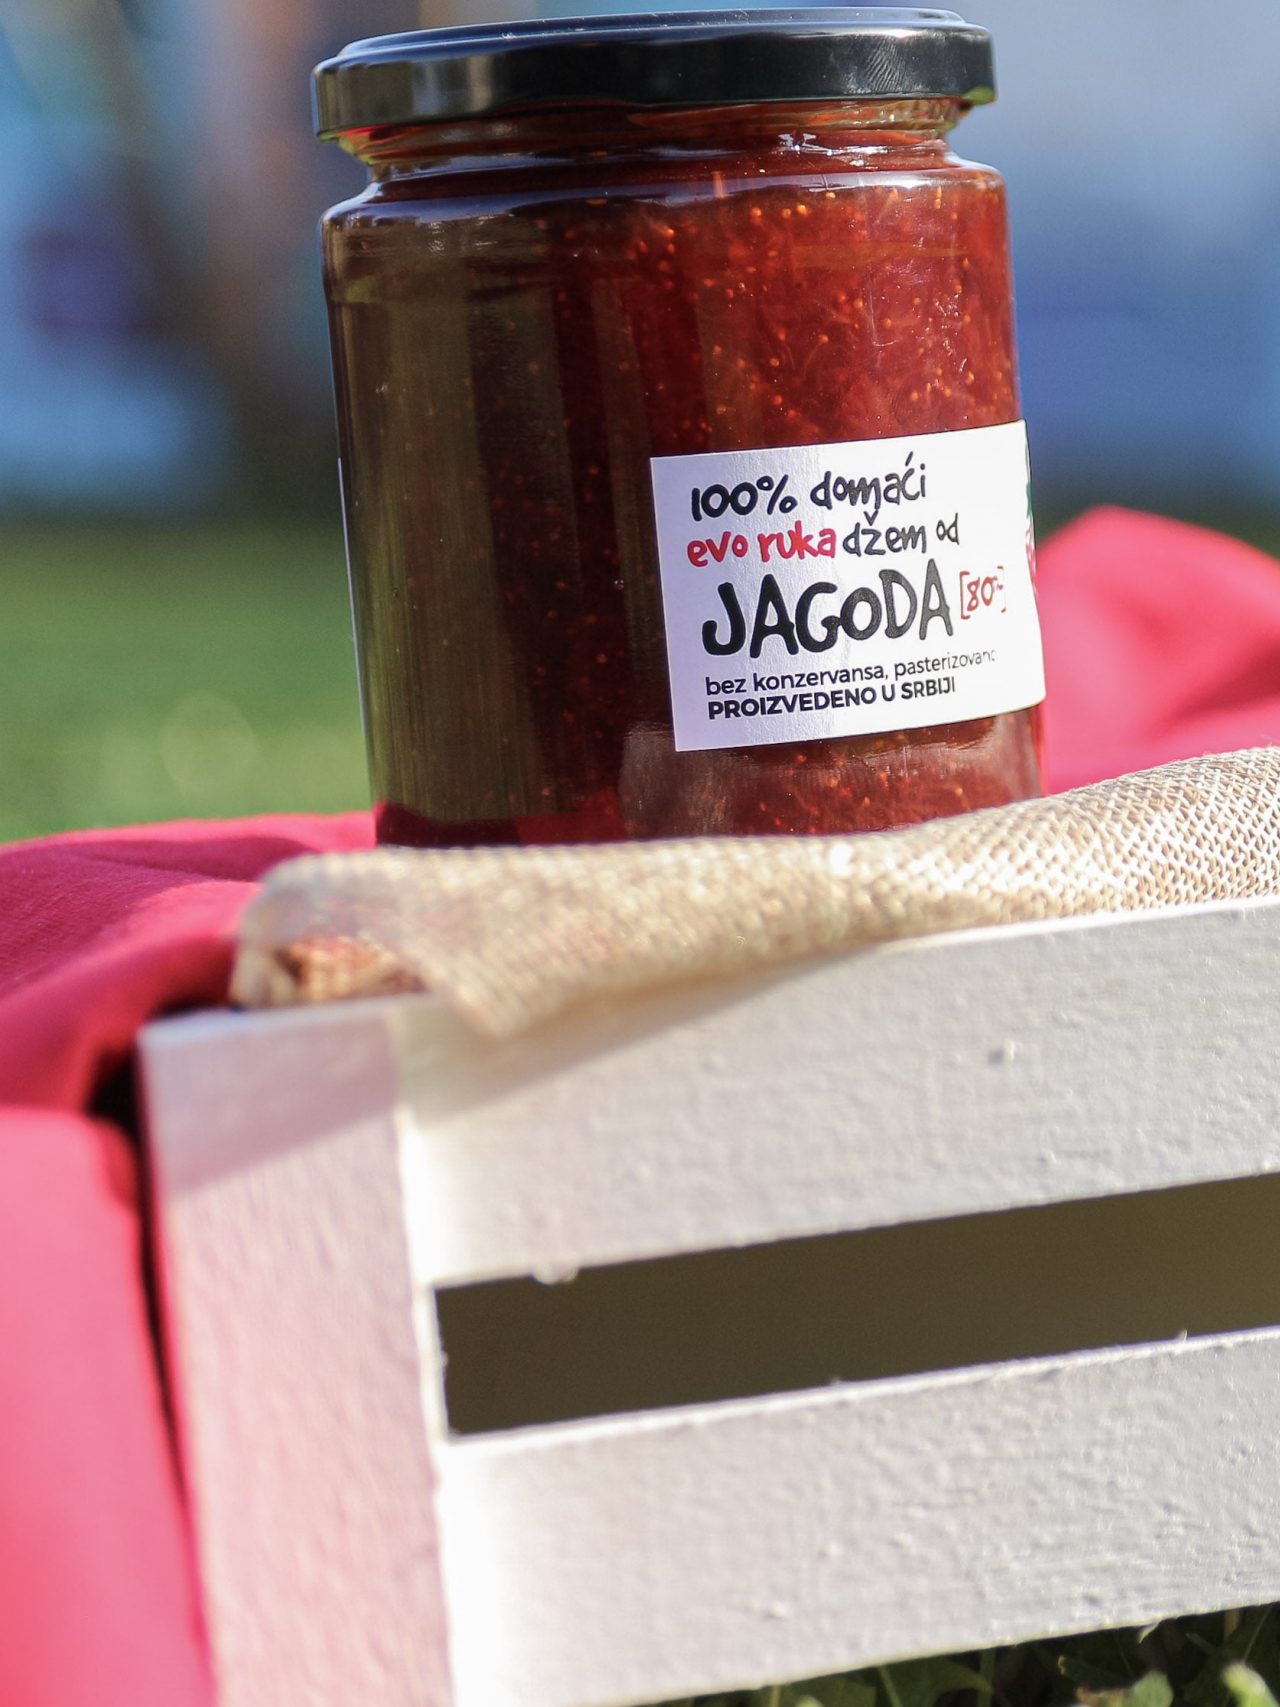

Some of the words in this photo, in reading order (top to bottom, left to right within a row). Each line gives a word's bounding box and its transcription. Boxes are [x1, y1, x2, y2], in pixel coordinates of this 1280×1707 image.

[692, 475, 798, 521] 100%
[810, 451, 926, 513] domaći
[687, 531, 749, 567] evo
[757, 521, 837, 562] ruka
[842, 509, 928, 557] džem
[936, 513, 960, 545] od
[702, 558, 954, 659] JAGODA
[705, 677, 746, 696] bez
[753, 664, 889, 692] konzervansa,
[708, 687, 877, 720] PROIZVEDENO
[881, 684, 896, 701] U
[901, 676, 956, 700] SRBIJI
